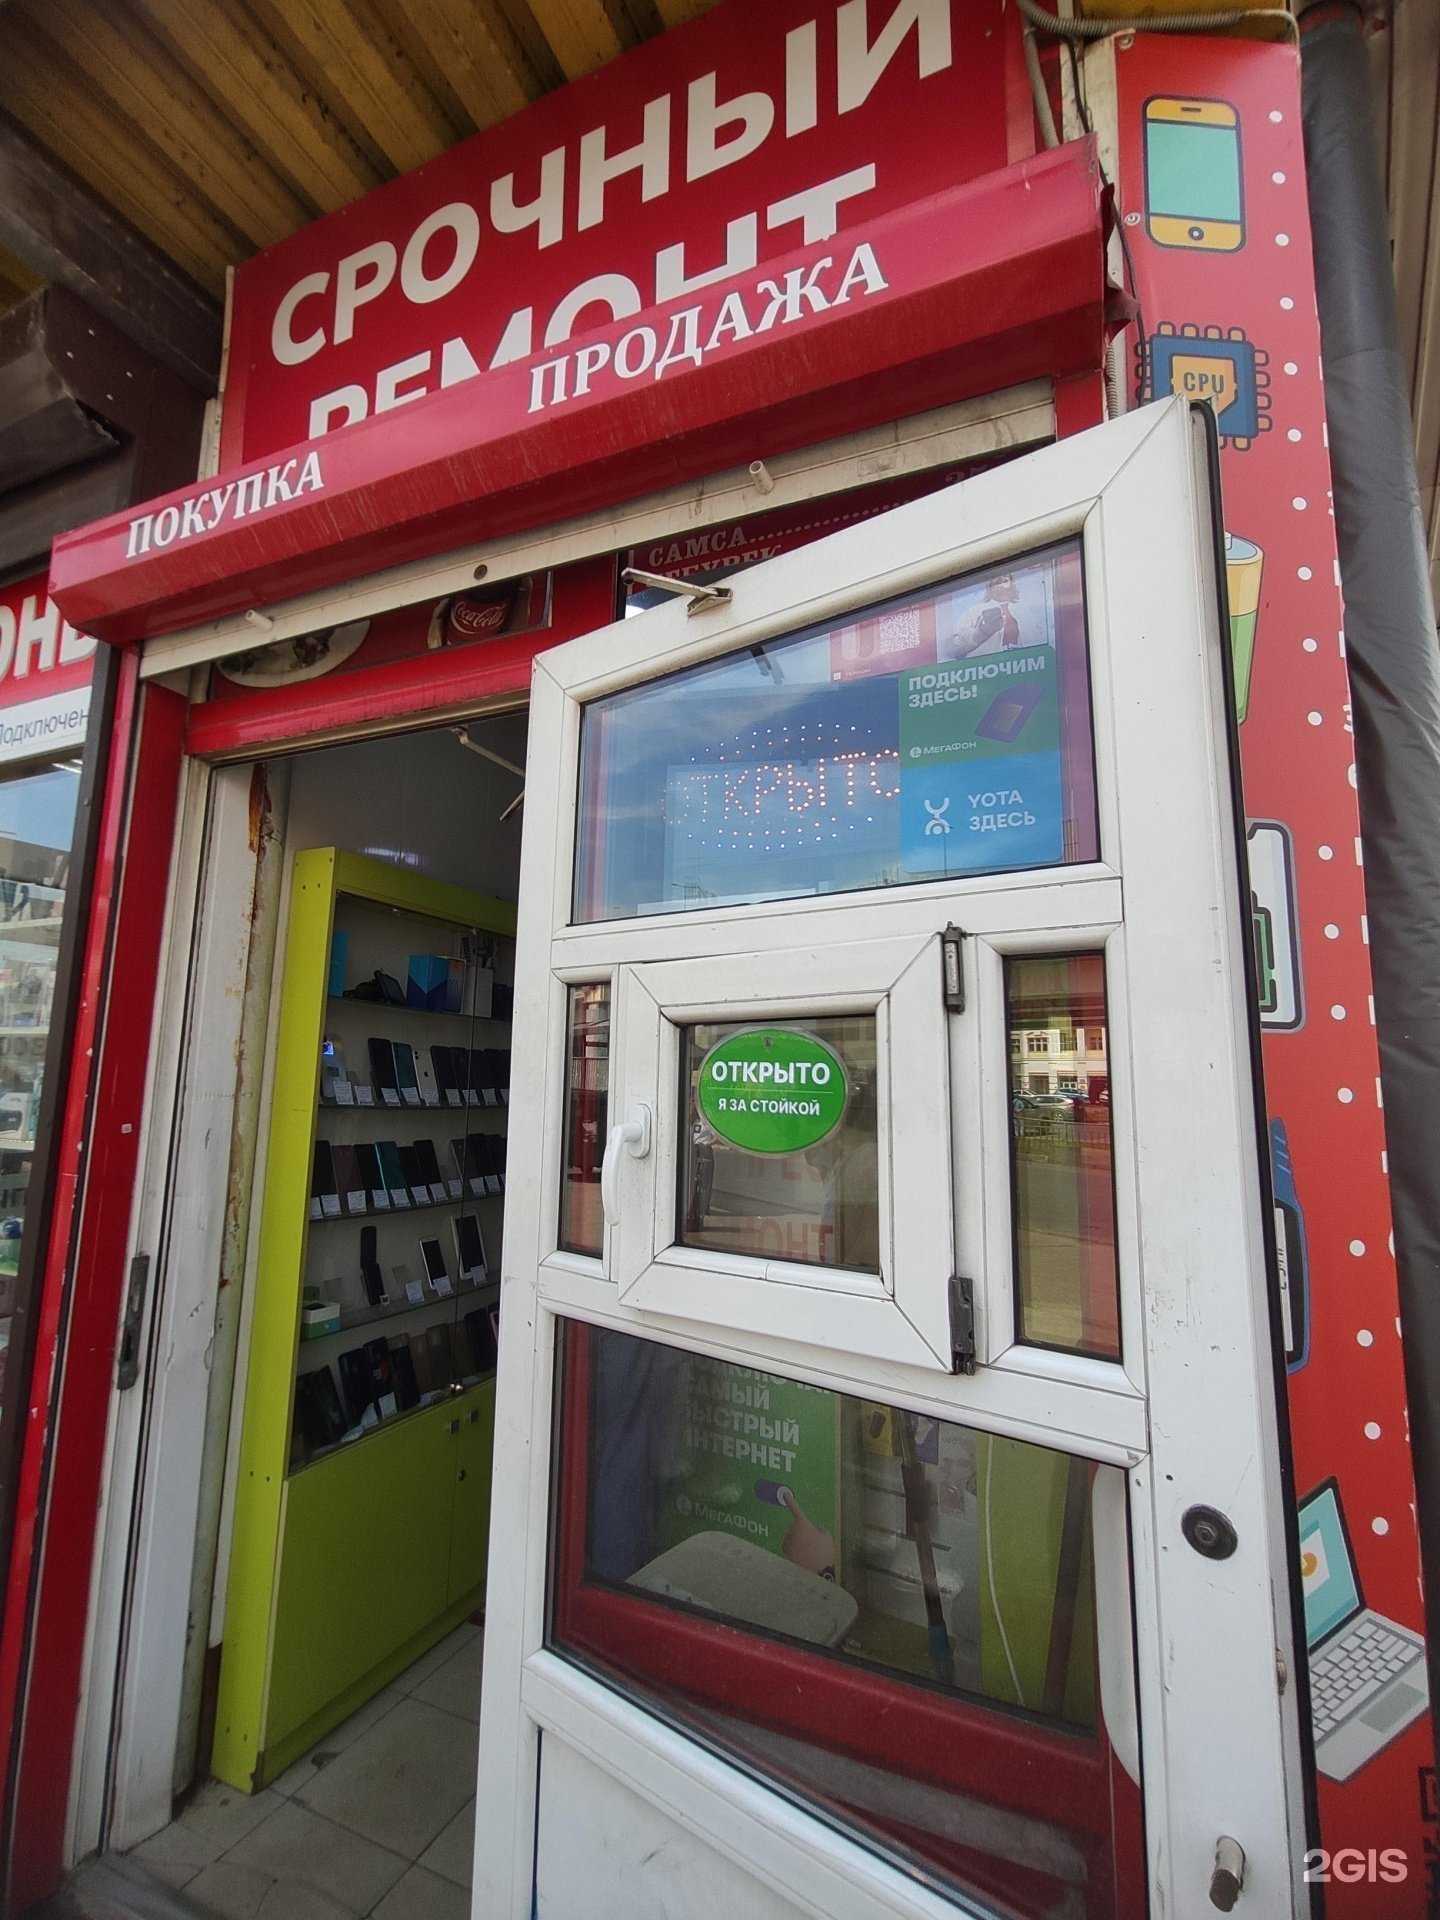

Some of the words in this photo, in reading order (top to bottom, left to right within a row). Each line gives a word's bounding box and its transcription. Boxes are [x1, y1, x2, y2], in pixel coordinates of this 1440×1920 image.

[271, 0, 953, 366] СРОЧНЫЙ
[528, 243, 888, 414] ПРОДАЖА
[1183, 371, 1225, 394] CPU
[126, 451, 324, 558] ПОКУПКА
[649, 526, 748, 567] САМСА
[908, 656, 1046, 692] ПОДКЛЮЧИМ
[908, 685, 978, 709] ЗДЕСЬ!
[922, 741, 977, 755] МЕГАФОН
[968, 789, 1024, 808] YOTA
[969, 810, 1036, 832] ЗДЕСЬ
[711, 1060, 830, 1085] ОТКРЫТО
[718, 1098, 727, 1111] Я
[730, 1099, 747, 1111] ЗА
[750, 1098, 820, 1116] СТОЙКОЙ
